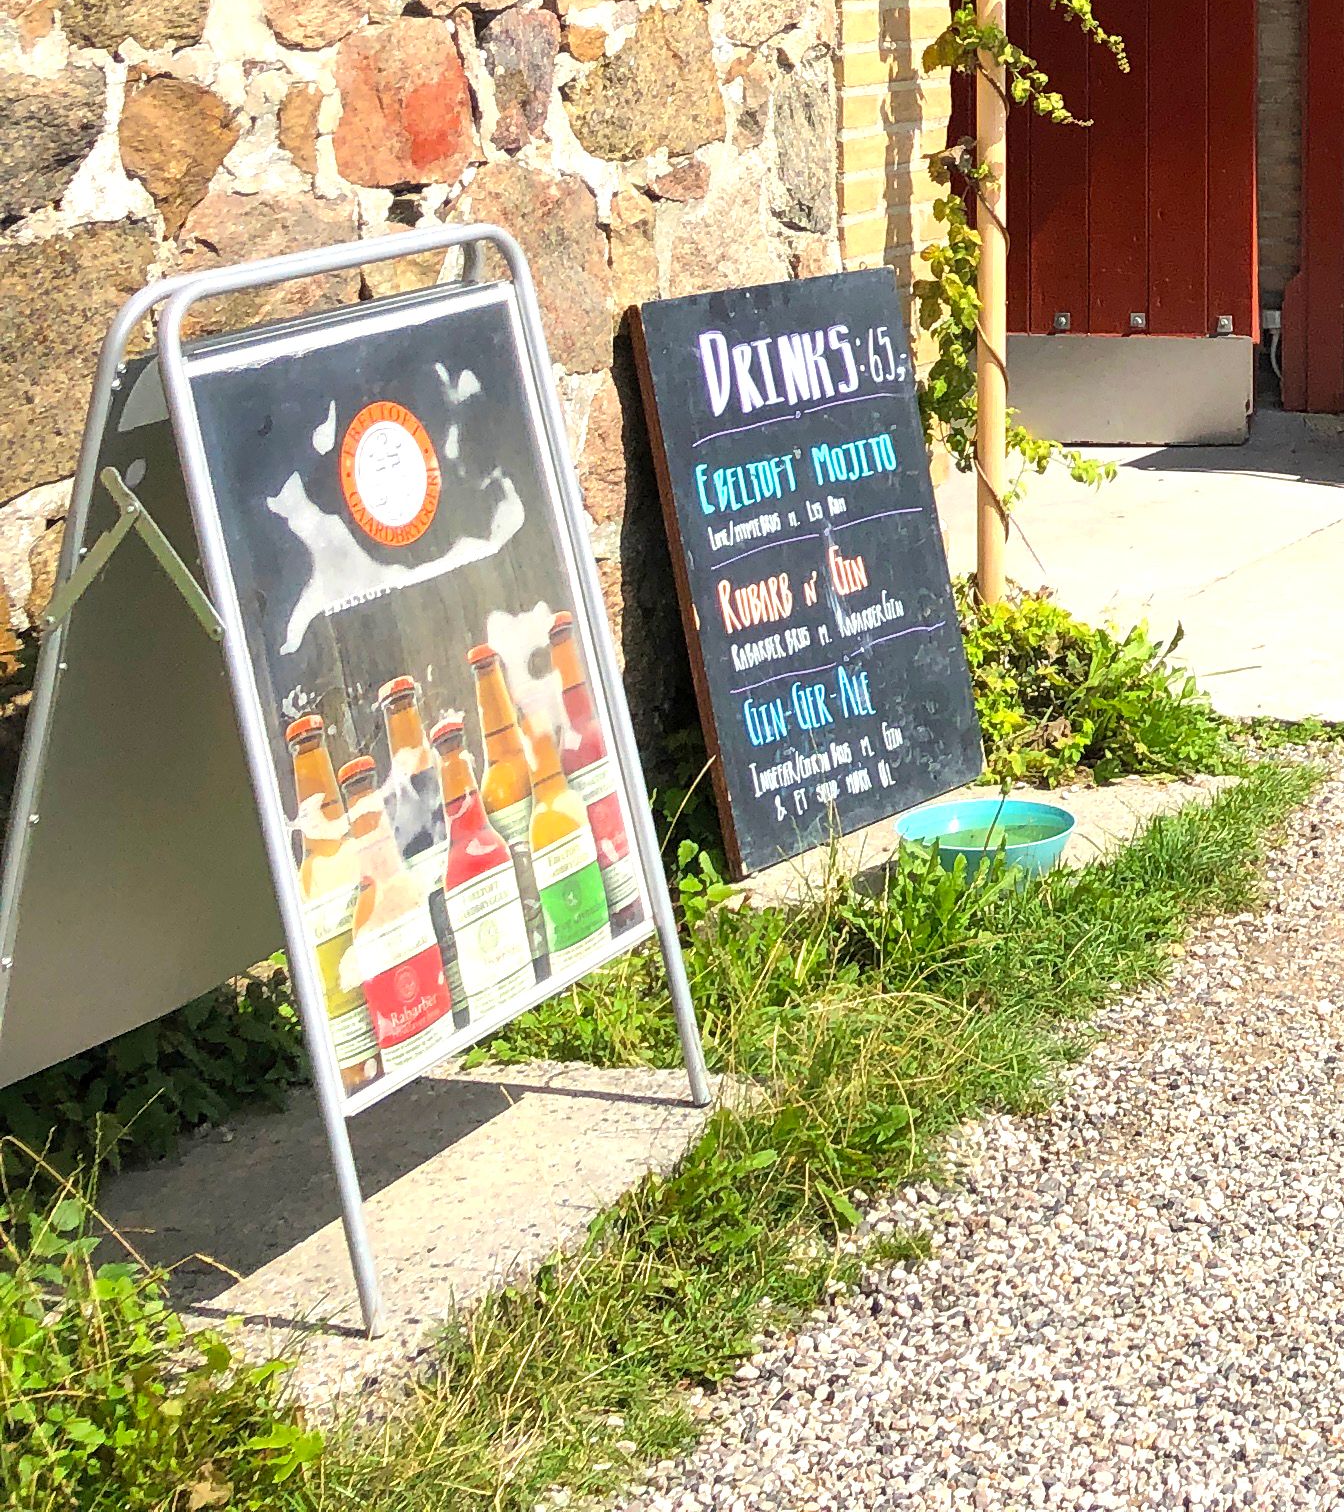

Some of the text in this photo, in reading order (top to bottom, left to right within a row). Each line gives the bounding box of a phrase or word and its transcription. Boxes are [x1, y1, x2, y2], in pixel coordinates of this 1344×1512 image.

[695, 433, 898, 515] EBELTOFT MOJITO
[717, 572, 794, 635] RUBARB
[827, 544, 869, 596] GIN
[881, 721, 904, 752] GIN
[774, 794, 788, 822] &
[793, 787, 809, 816] ET
[877, 758, 897, 789] ØL
